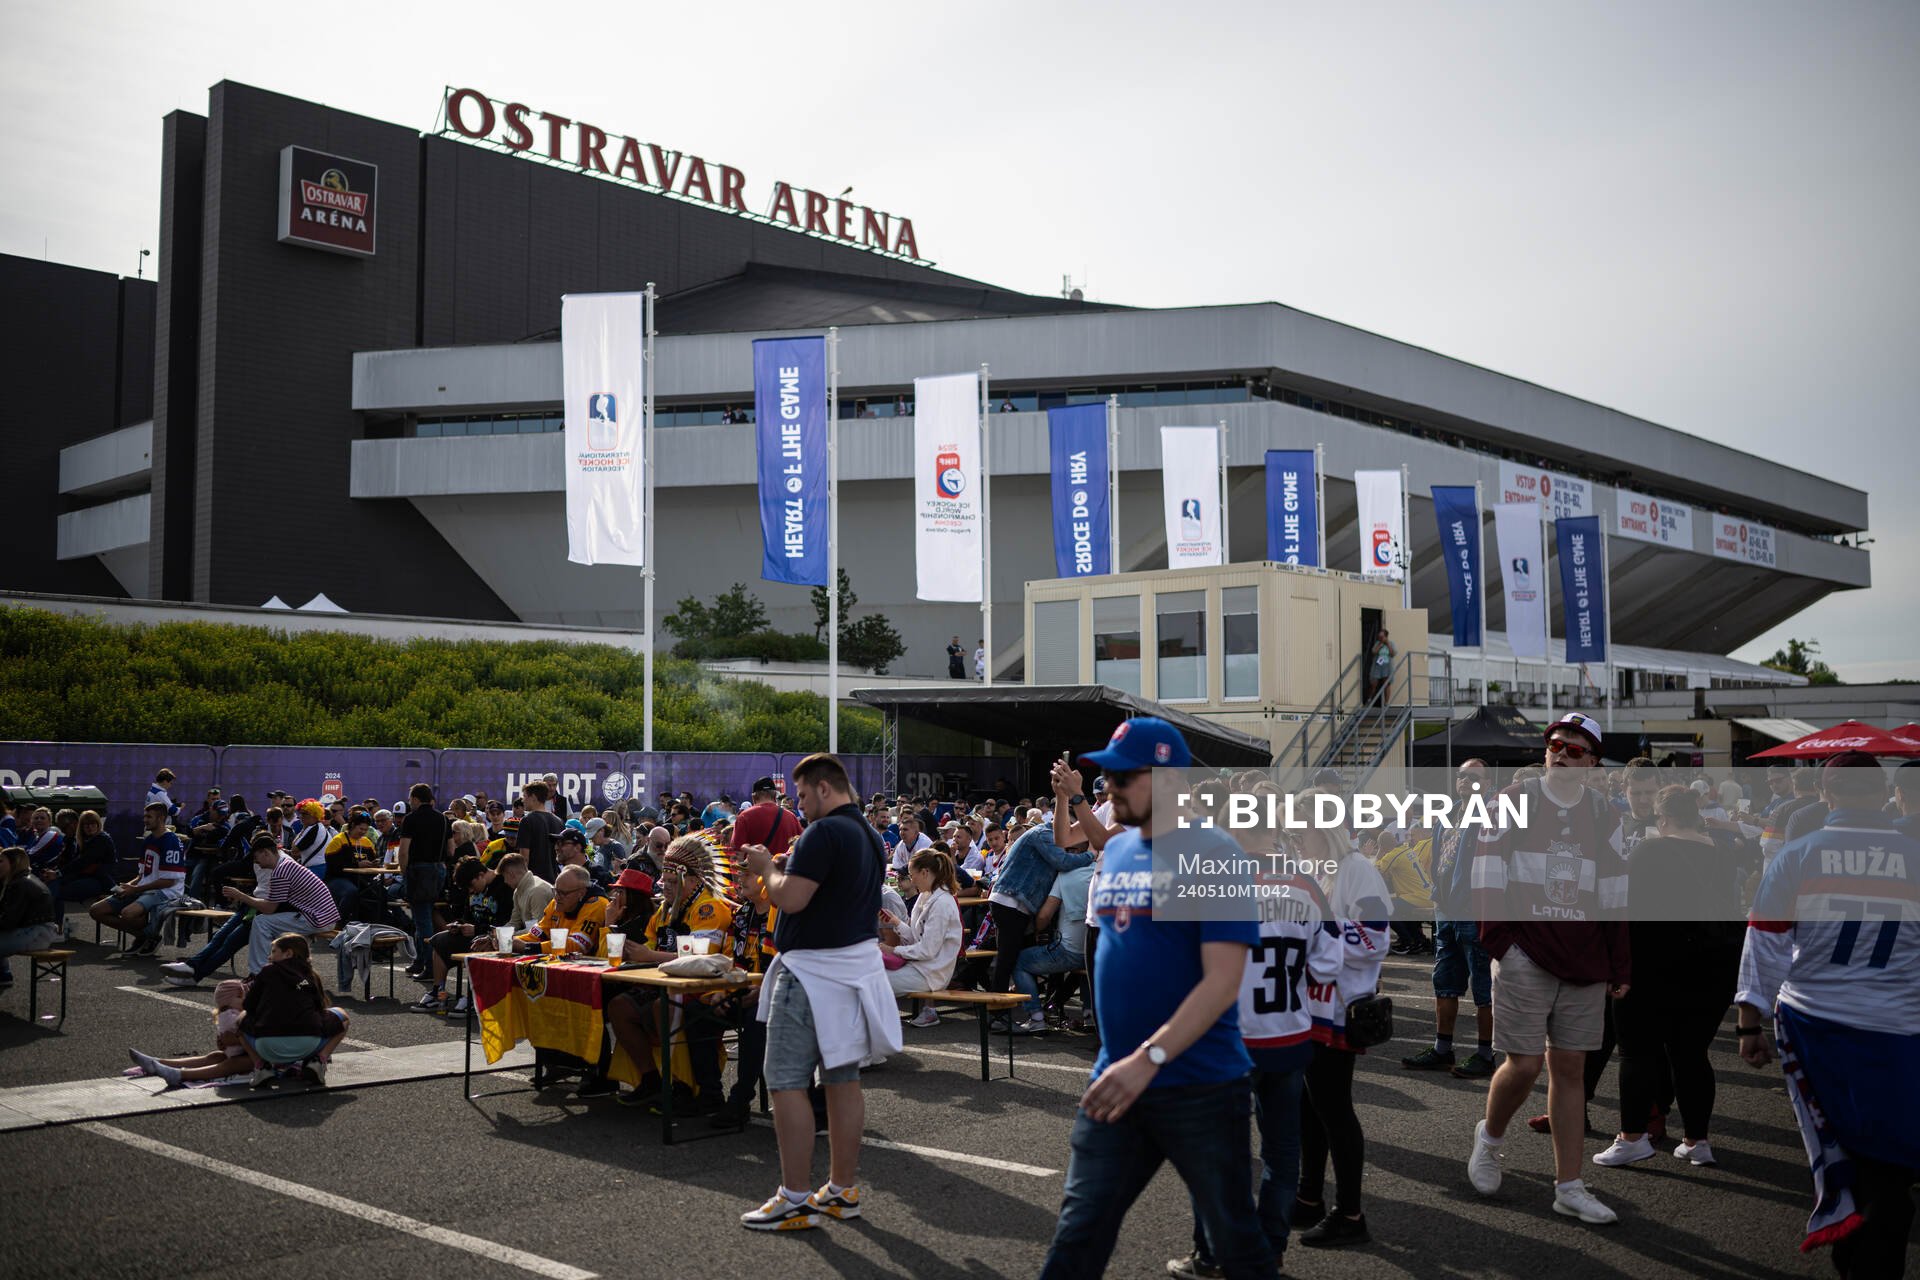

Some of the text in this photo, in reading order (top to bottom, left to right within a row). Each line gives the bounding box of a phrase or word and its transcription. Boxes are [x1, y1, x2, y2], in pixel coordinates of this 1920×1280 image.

[447, 88, 921, 260] OSTRAVAR ARÉNA
[306, 186, 361, 211] OSTRAVAR
[301, 207, 367, 232] ARÉNA
[165, 850, 180, 864] 20
[1821, 846, 1907, 879] RUŽA
[1828, 898, 1903, 969] 77
